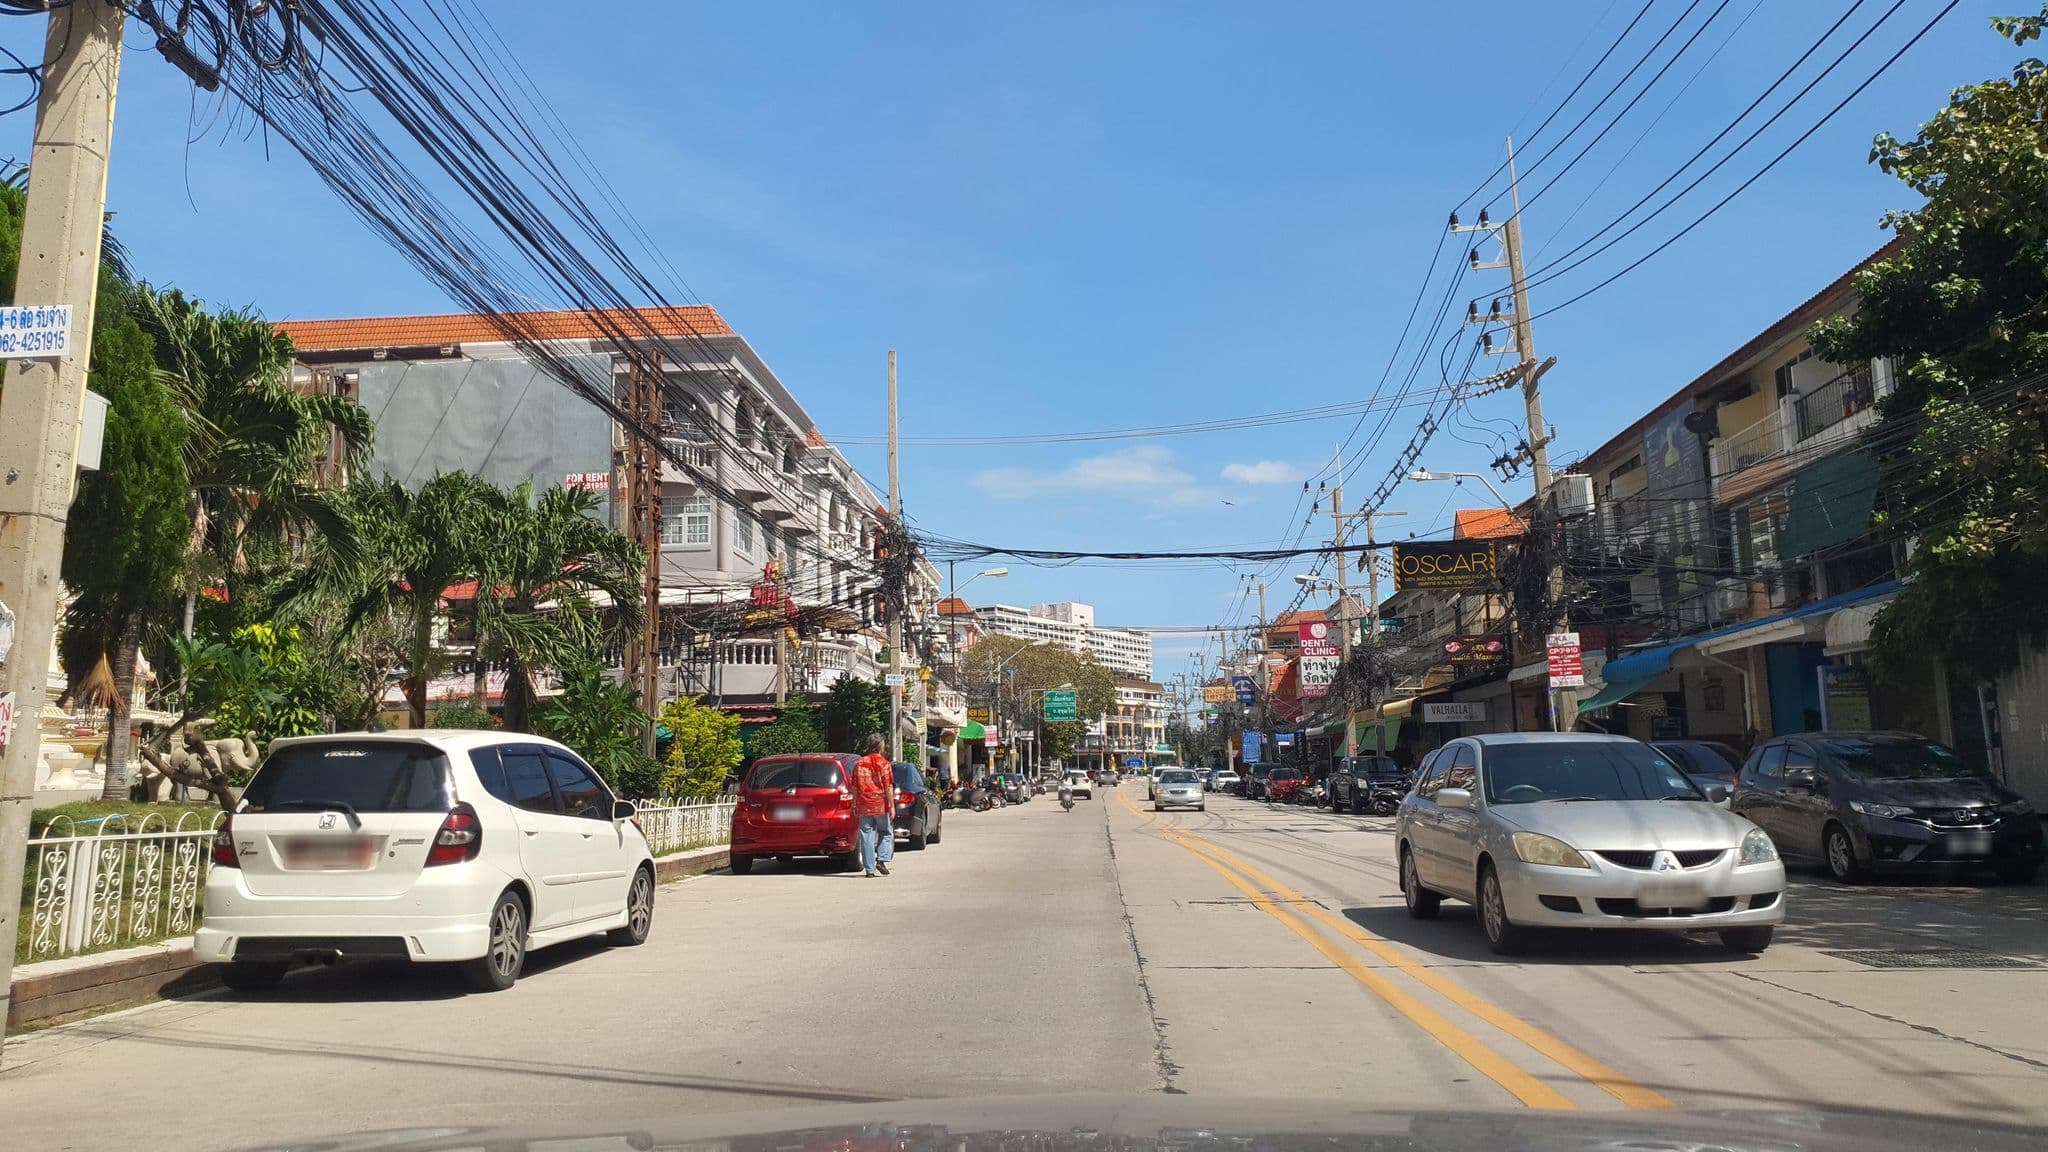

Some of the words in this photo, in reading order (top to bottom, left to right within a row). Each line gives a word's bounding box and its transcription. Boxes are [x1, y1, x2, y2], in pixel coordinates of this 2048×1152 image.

[0, 330, 65, 353] 62-4251915
[566, 473, 583, 483] FOR
[586, 472, 609, 482] RENT
[1401, 552, 1489, 575] OSCAR
[1304, 647, 1336, 656] CLINIC
[1431, 704, 1468, 715] VALHALLA
